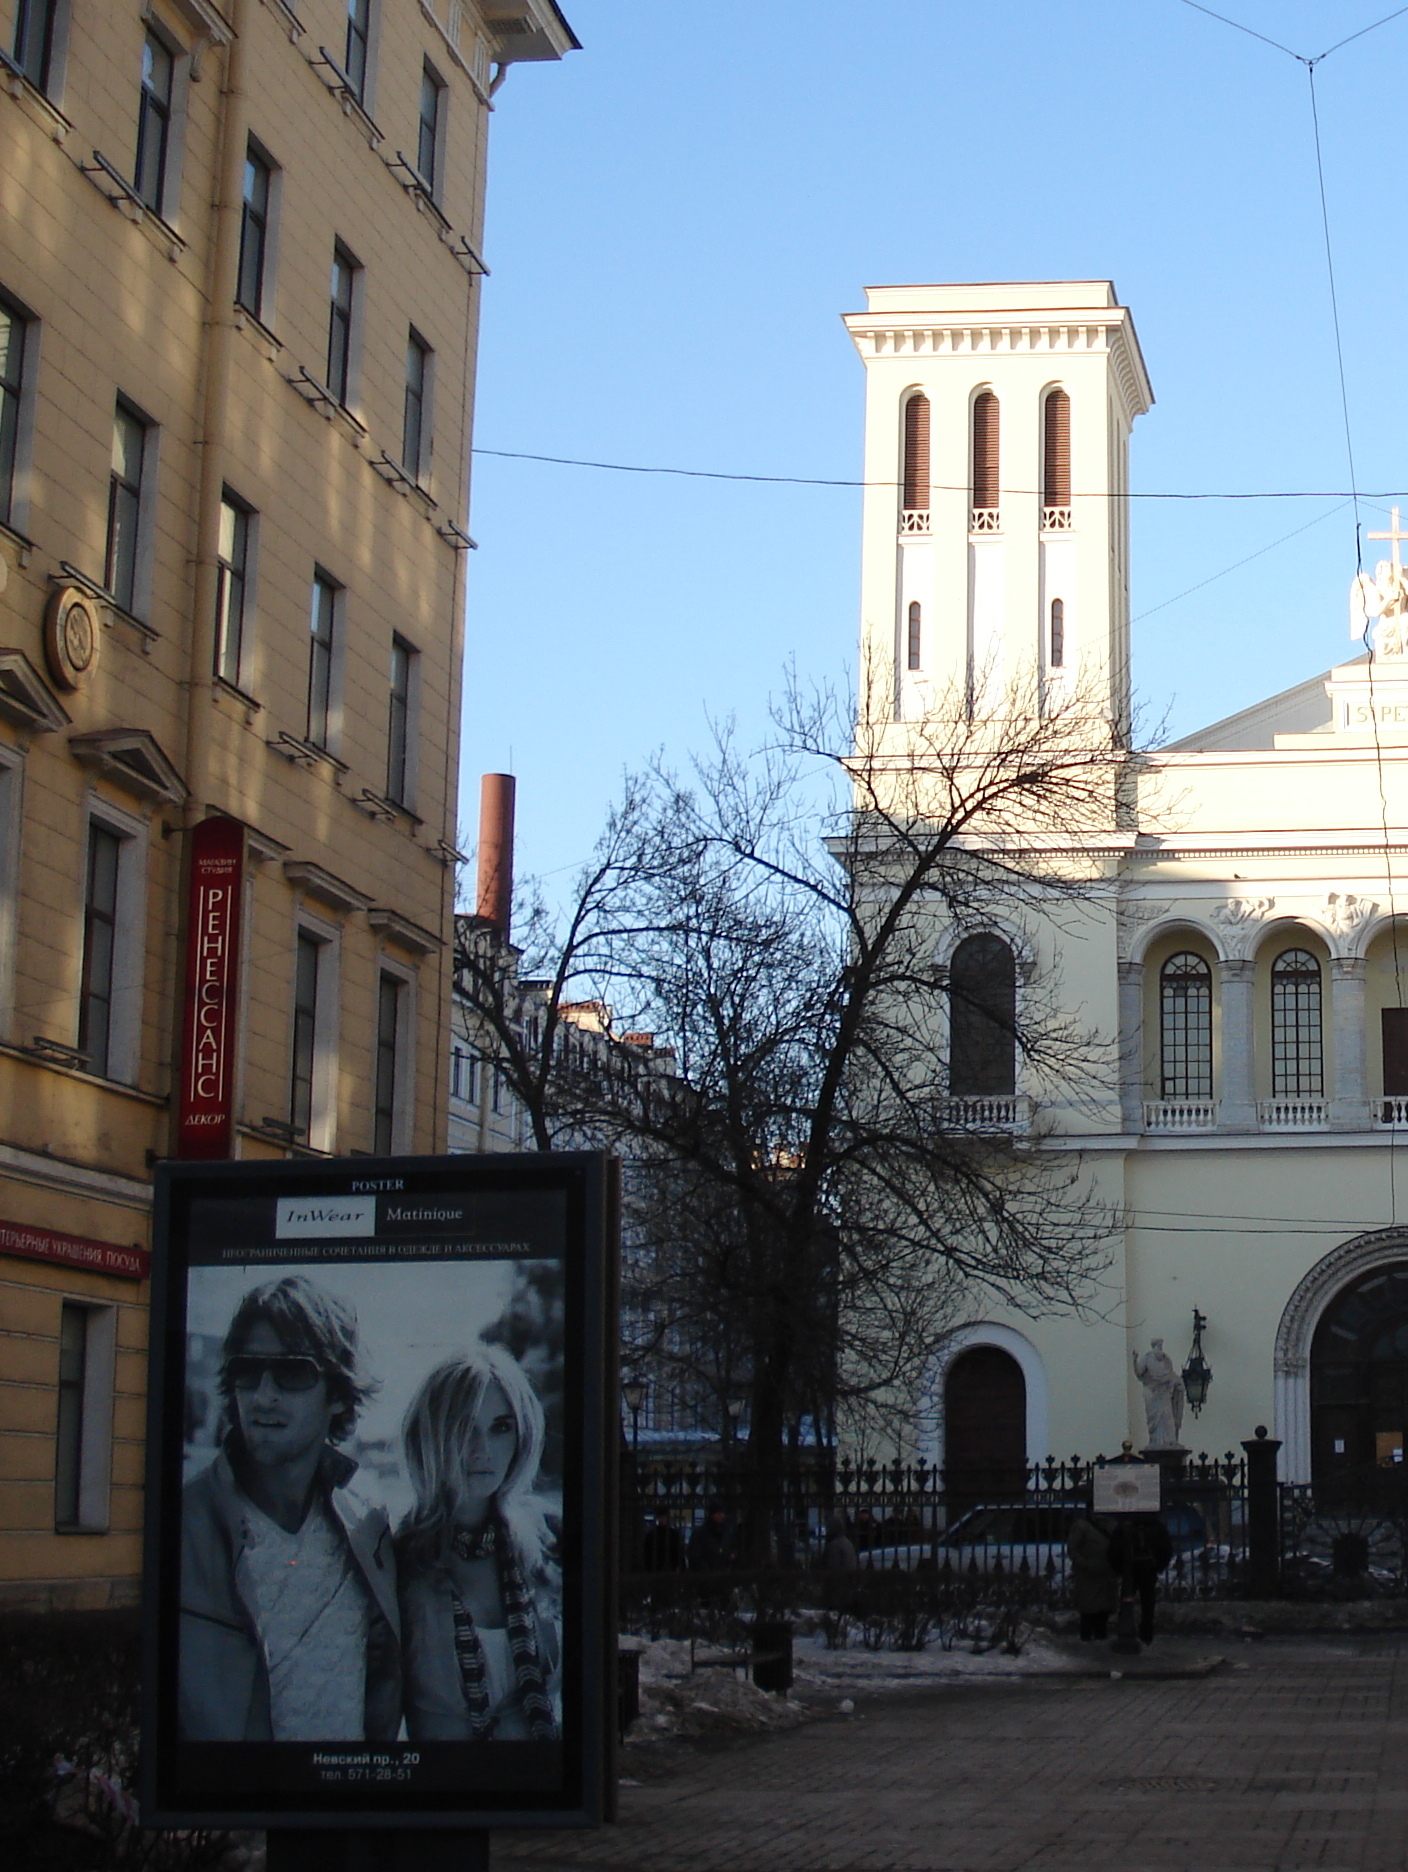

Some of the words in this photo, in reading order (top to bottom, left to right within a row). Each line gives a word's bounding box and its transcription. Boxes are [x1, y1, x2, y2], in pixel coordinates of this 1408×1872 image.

[197, 889, 223, 1098] РЕНЕССАНС
[184, 1114, 225, 1125] ДЕКОР
[352, 1179, 405, 1192] POSTER
[286, 1209, 365, 1223] InWear
[386, 1207, 463, 1222] Matinique
[0, 1229, 50, 1254] ТЕРЬЕРНЫЕ
[322, 1245, 386, 1257] СОЧЕТАНИЯ
[388, 1245, 396, 1255] В
[456, 1241, 531, 1253] АКСЕССУАРАХ
[313, 1752, 370, 1765] Невский
[402, 1752, 420, 1765] 20
[348, 1768, 411, 1780] 571-28-51
